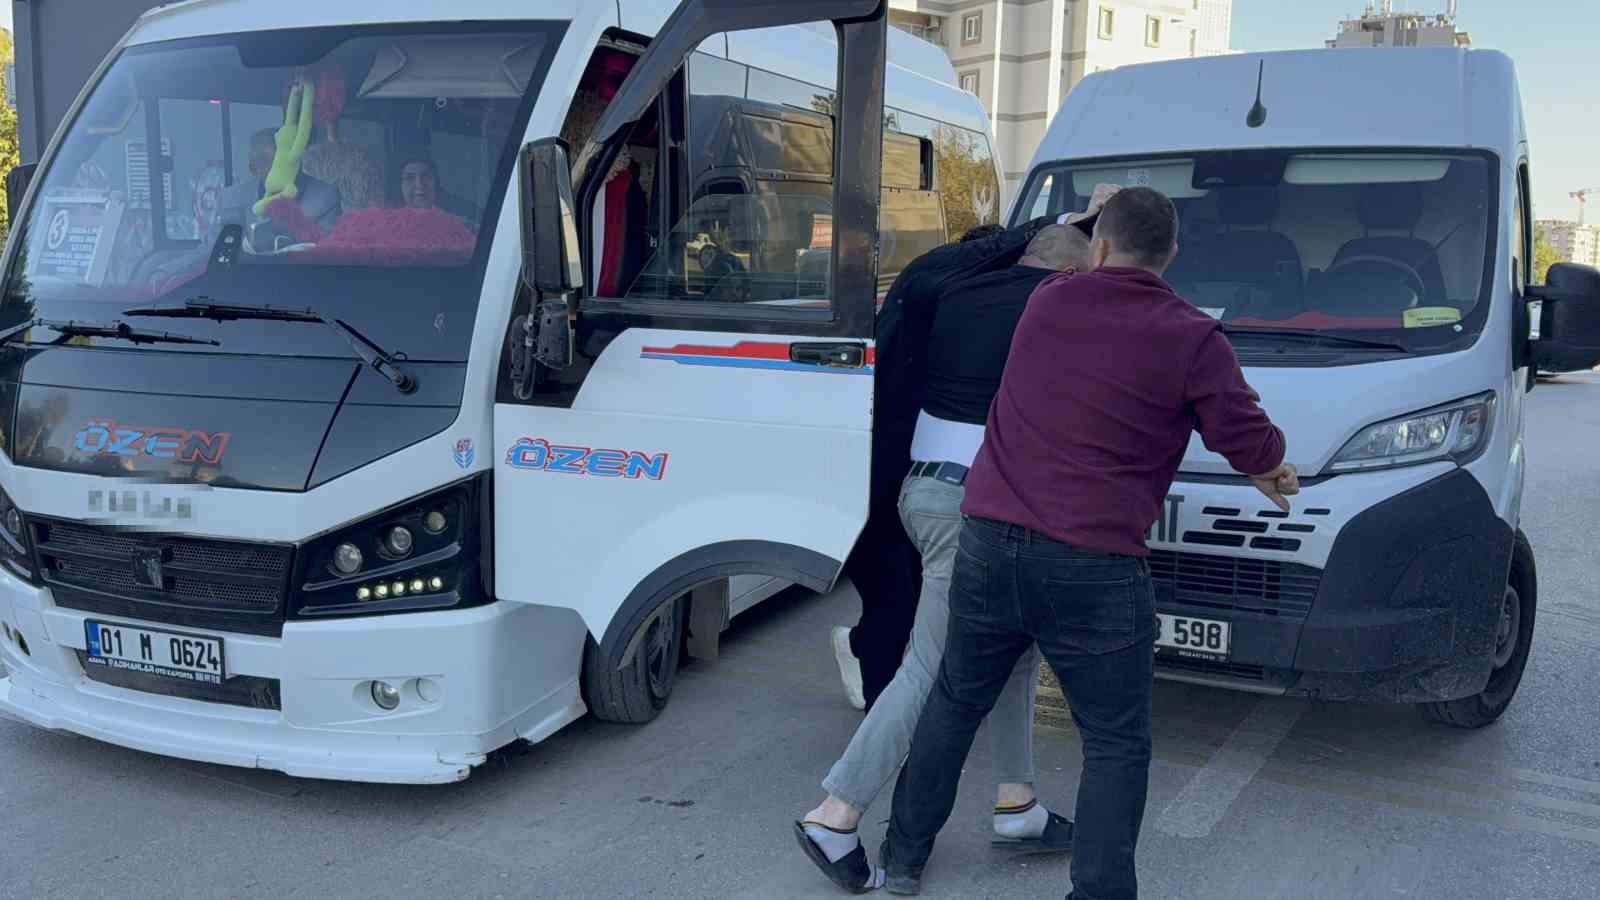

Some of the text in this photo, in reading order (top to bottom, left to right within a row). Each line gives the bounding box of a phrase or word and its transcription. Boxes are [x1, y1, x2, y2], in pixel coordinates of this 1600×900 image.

[75, 419, 231, 464] ÖZEN
[506, 437, 668, 480] ÖZEN
[101, 628, 219, 671] 01 M 0624
[1174, 619, 1221, 649] 598
